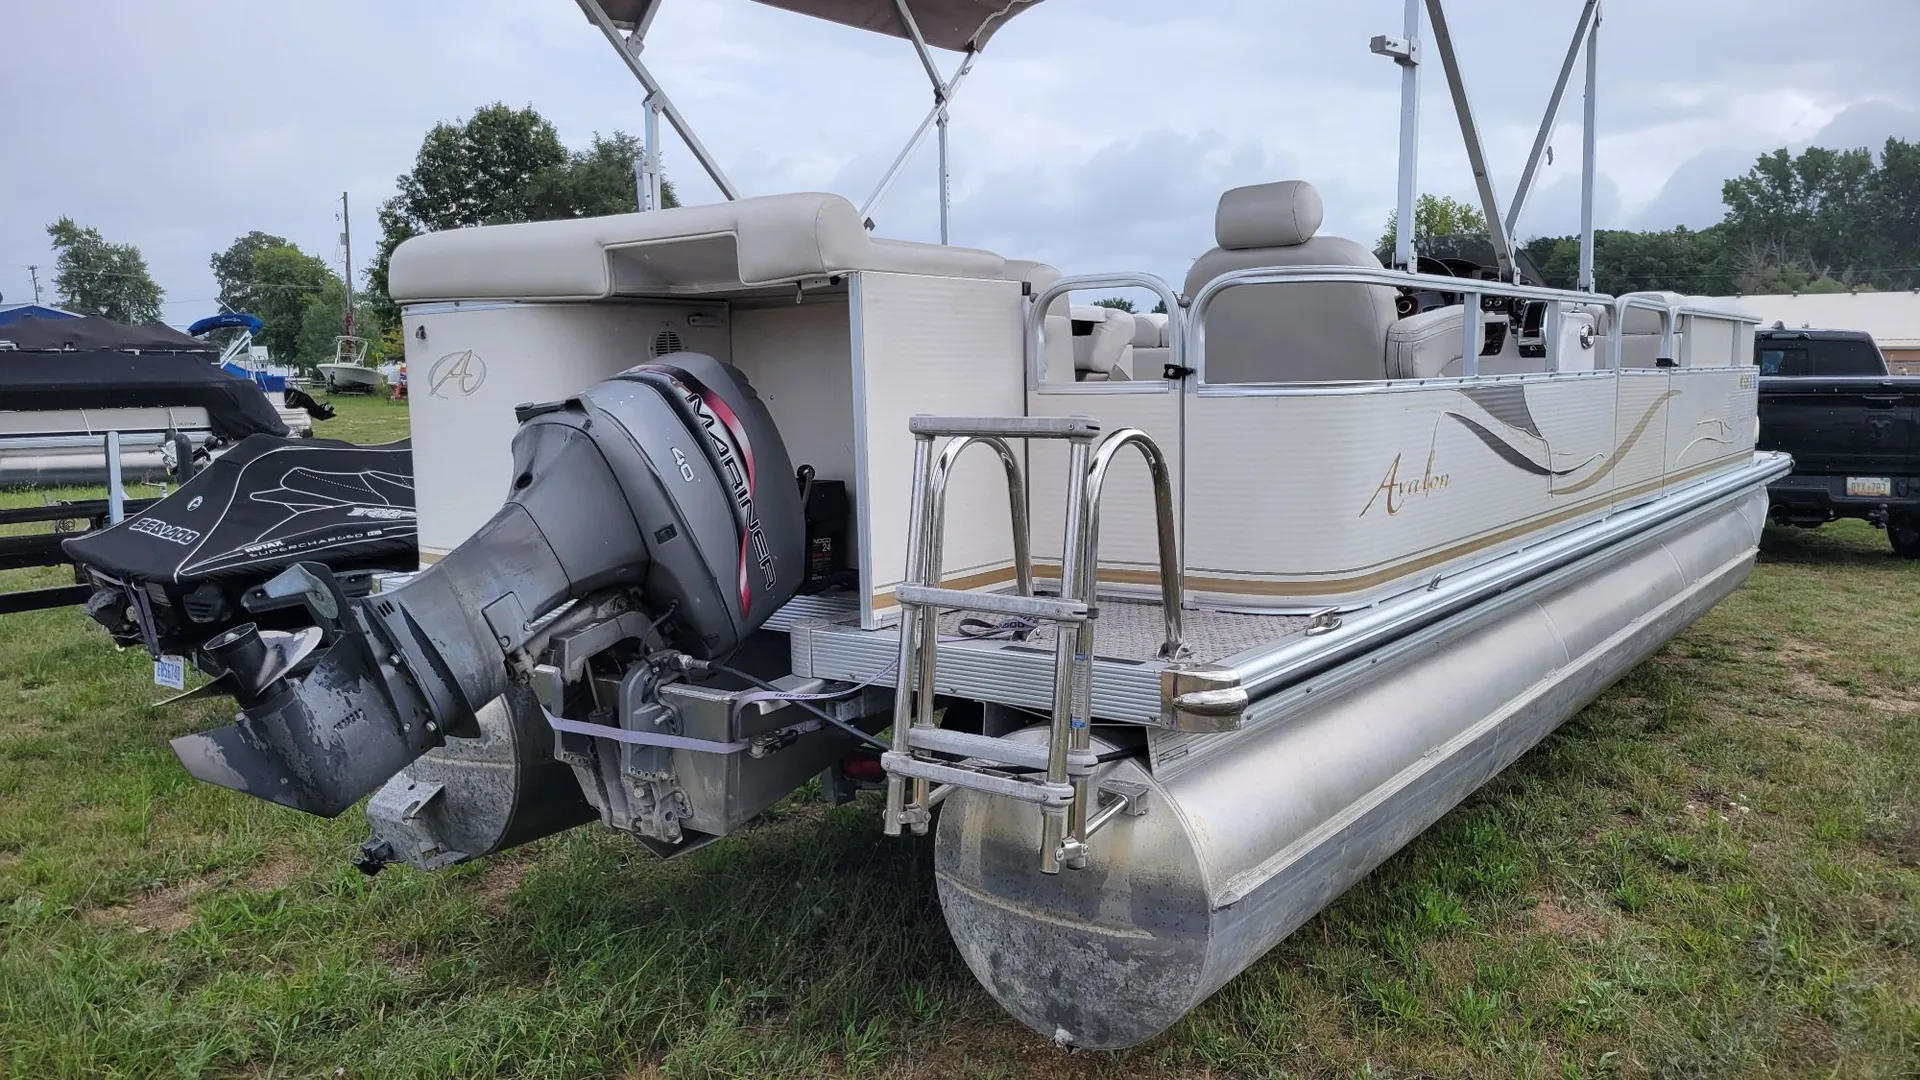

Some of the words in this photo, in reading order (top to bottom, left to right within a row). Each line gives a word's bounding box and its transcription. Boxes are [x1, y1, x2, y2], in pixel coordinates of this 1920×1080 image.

[671, 446, 695, 482] 40
[1359, 446, 1450, 517] Avalon
[686, 393, 777, 591] MARINER
[822, 543, 831, 552] 24
